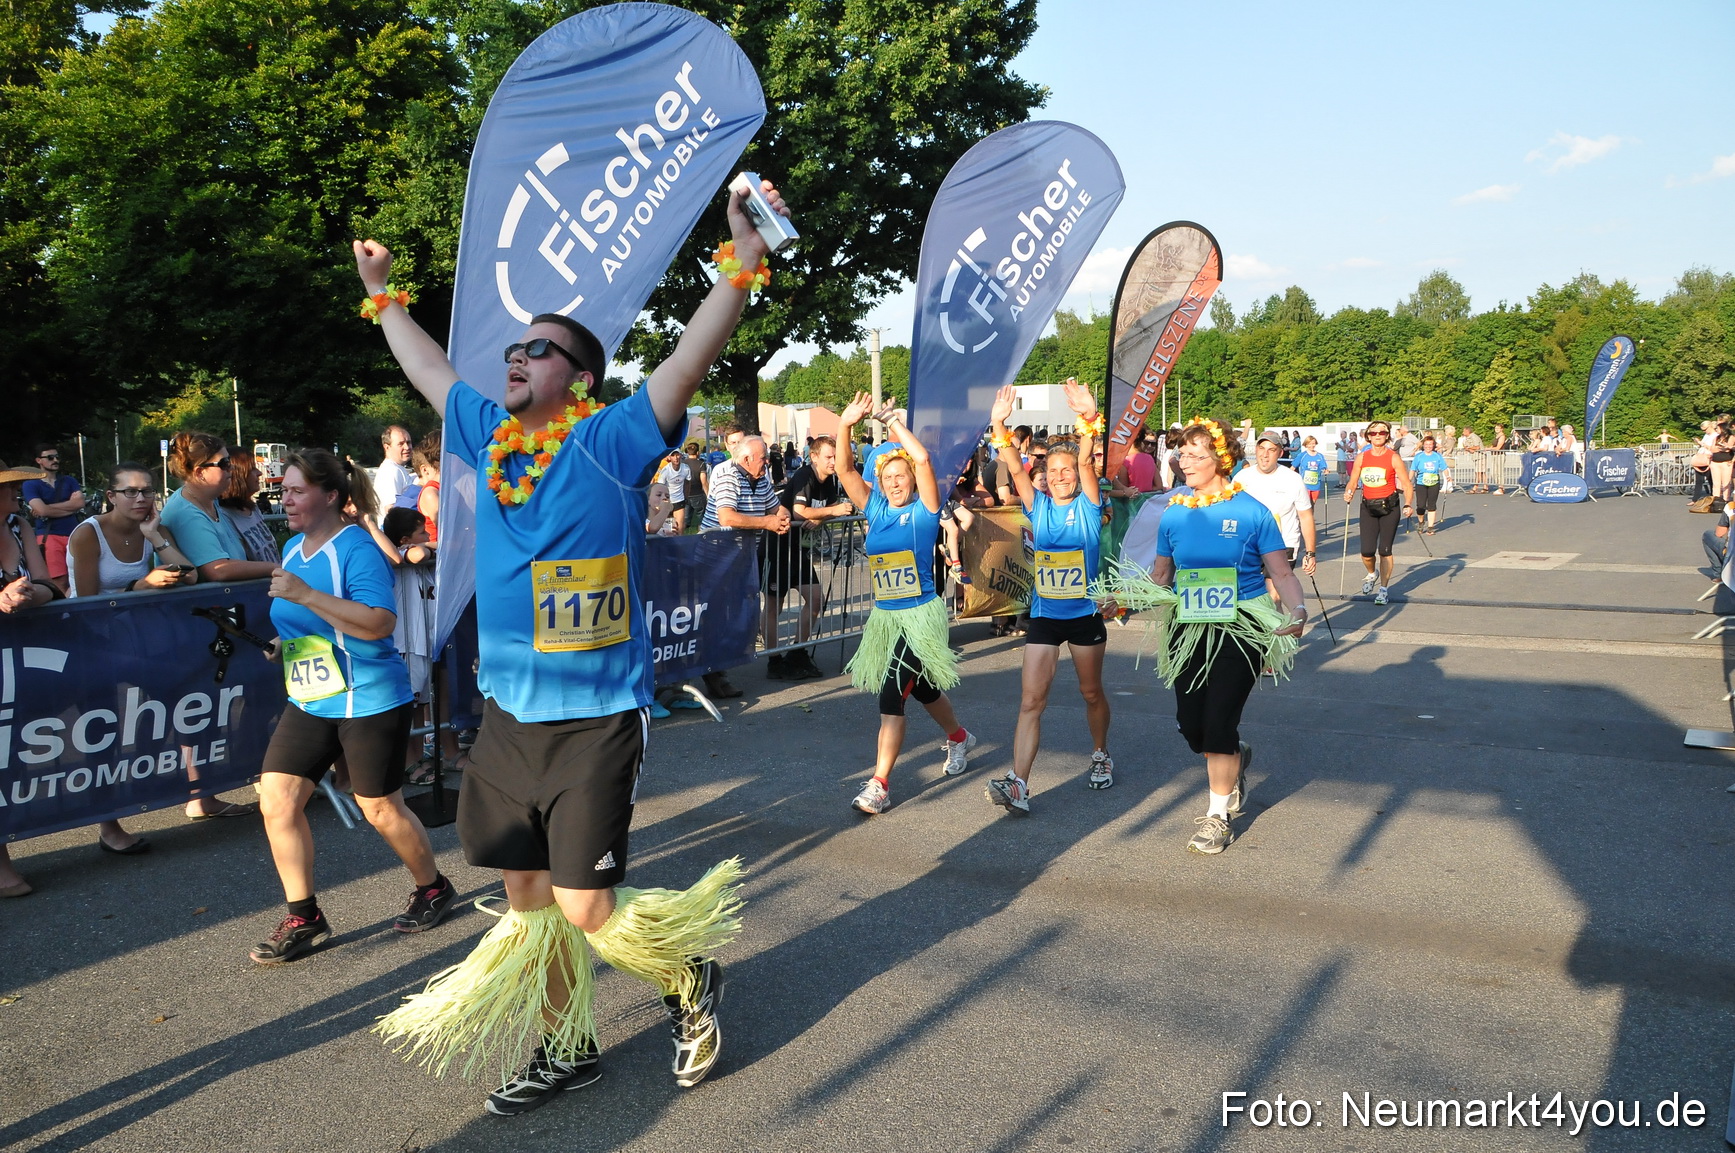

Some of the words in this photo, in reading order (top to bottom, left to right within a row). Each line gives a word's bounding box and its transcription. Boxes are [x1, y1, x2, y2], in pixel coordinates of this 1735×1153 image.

[538, 61, 702, 286] Fischer
[601, 107, 721, 284] AUTOMOBILE
[967, 158, 1078, 325] Fischer
[1008, 189, 1092, 322] AUTOMOBILE
[1588, 359, 1620, 408] Frischmann
[1365, 475, 1380, 483] 587
[1602, 465, 1628, 477] Fischer
[1543, 485, 1581, 494] Fischer
[549, 575, 587, 584] firmenlauf
[874, 566, 917, 588] 1175
[1037, 567, 1083, 587] 1172
[540, 586, 626, 629] 1170
[1180, 587, 1234, 609] 1162
[291, 657, 330, 686] 475
